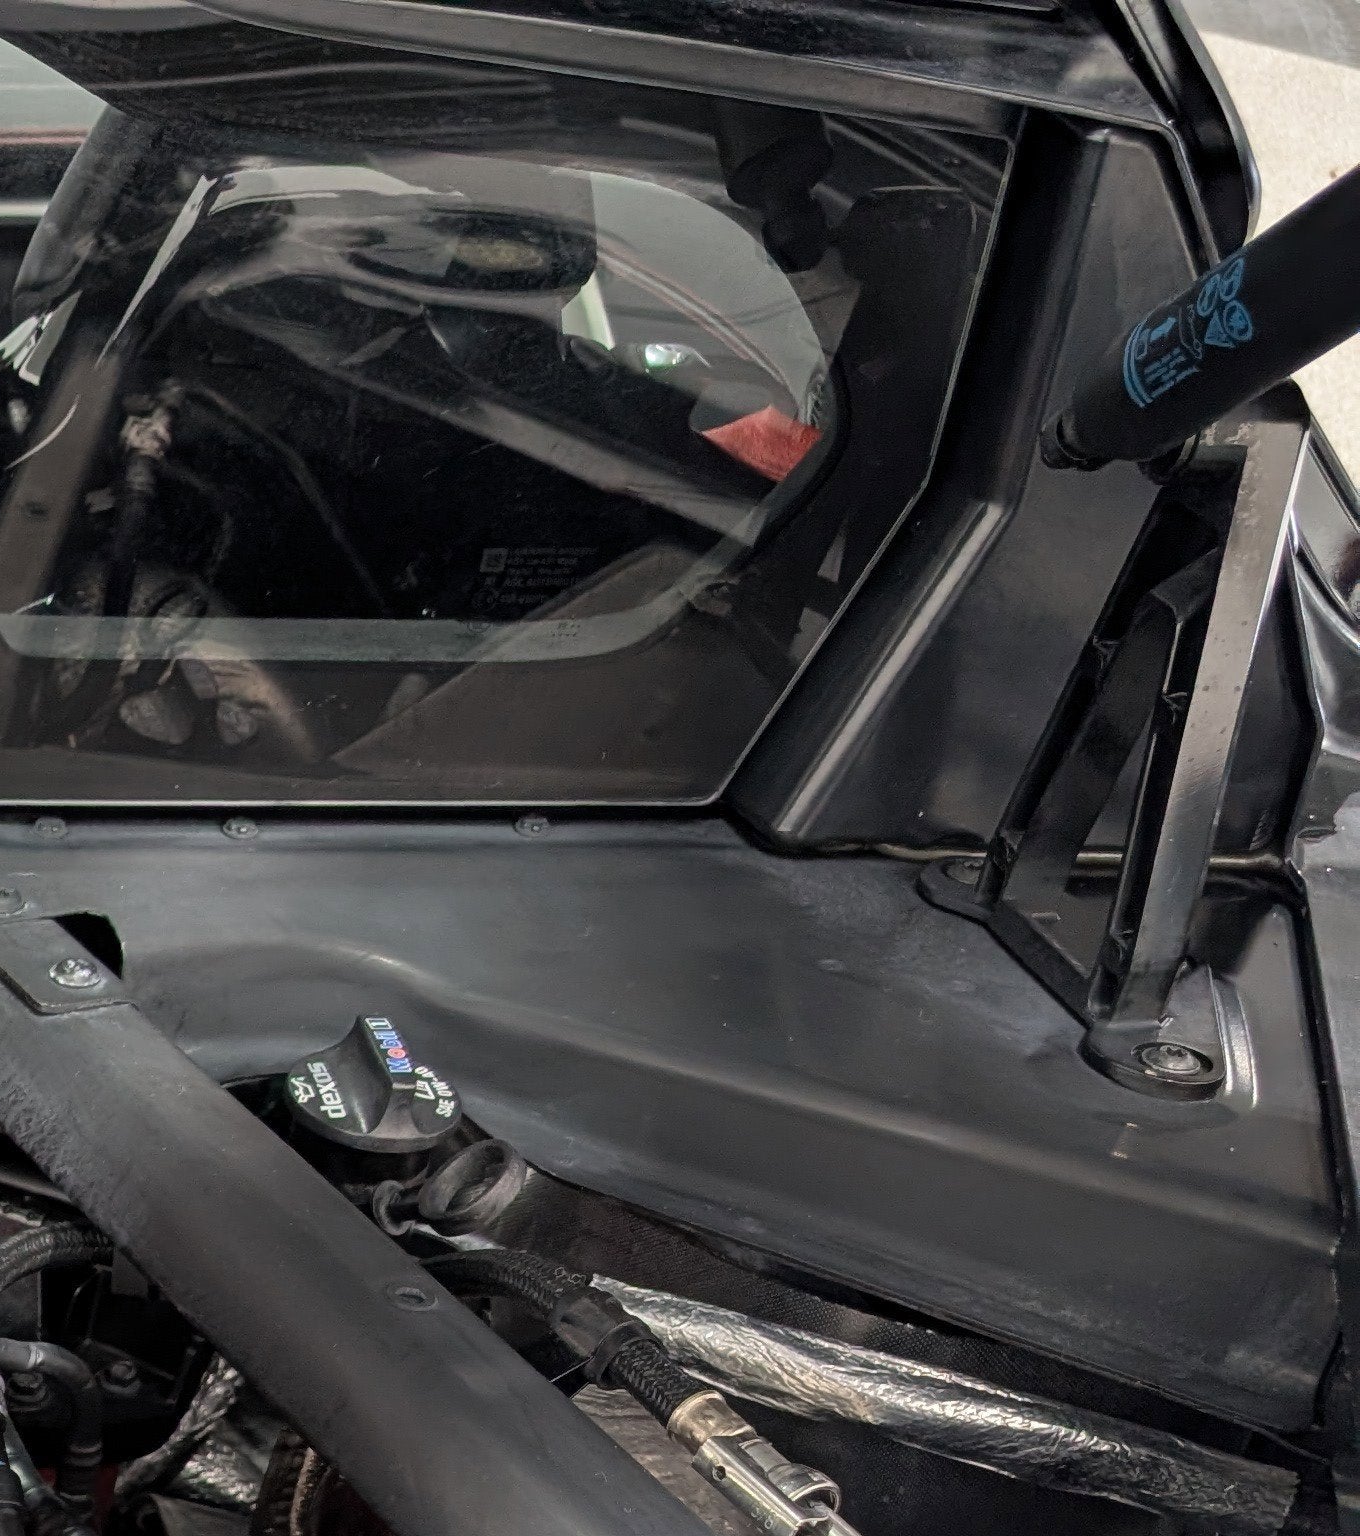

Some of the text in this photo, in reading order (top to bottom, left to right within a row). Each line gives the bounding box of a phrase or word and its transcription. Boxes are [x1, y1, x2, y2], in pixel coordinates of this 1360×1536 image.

[374, 1031, 413, 1073] Mobil
[307, 1062, 347, 1119] dexos
[414, 1066, 455, 1118] SAE 0W-40
